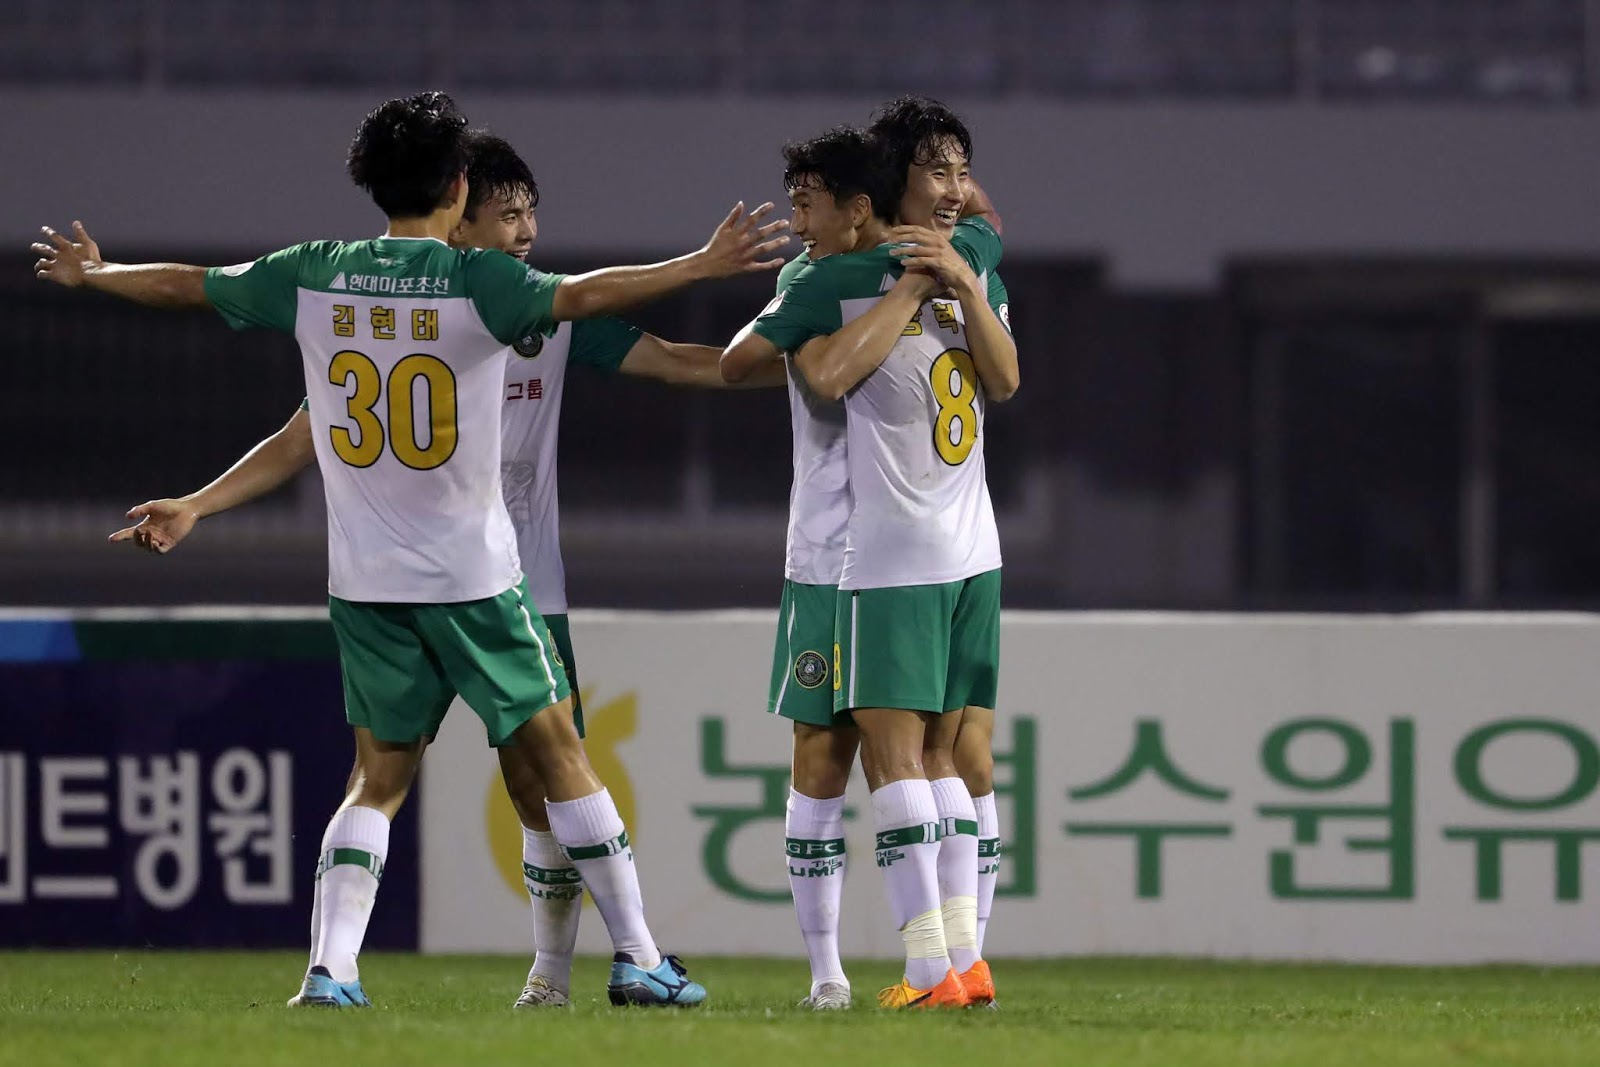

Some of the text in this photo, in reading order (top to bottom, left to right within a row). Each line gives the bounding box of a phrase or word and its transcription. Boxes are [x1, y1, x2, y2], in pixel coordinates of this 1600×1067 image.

[349, 273, 449, 295] 현대미포조선
[328, 350, 459, 470] 30
[507, 379, 542, 400] 그룹
[929, 348, 977, 466] 8
[692, 715, 1600, 904] 농수원유
